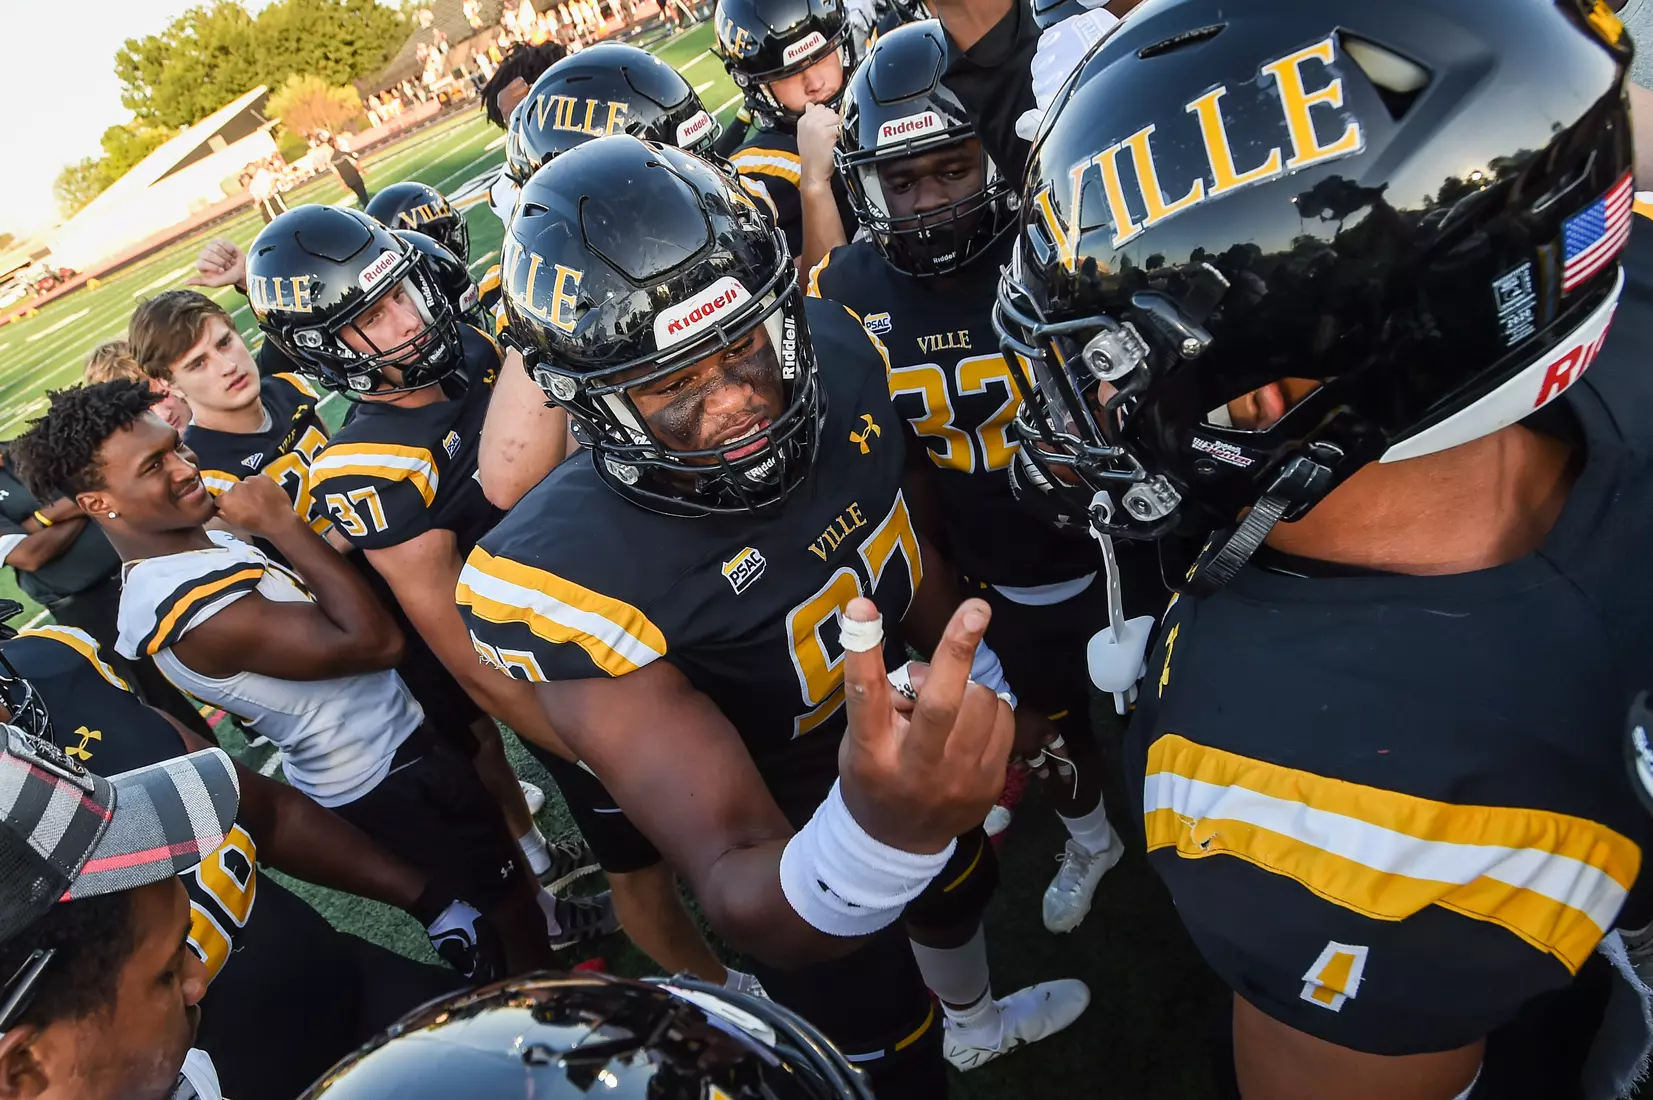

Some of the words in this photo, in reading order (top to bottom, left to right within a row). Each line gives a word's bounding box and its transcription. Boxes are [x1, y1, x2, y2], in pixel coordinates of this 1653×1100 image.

[787, 35, 821, 59] Riddell
[536, 93, 629, 138] VILLE
[682, 115, 709, 138] Riddell
[882, 115, 934, 139] Riddell
[1033, 36, 1366, 277] VILLE
[363, 252, 398, 284] Riddell
[667, 282, 742, 337] Riddell
[865, 317, 890, 330] PSAC
[916, 330, 972, 355] VILLE
[890, 352, 1037, 475] 32
[325, 485, 389, 537] 37
[807, 501, 868, 562] VILLE
[731, 551, 763, 586] PSAC
[785, 487, 924, 741] 97
